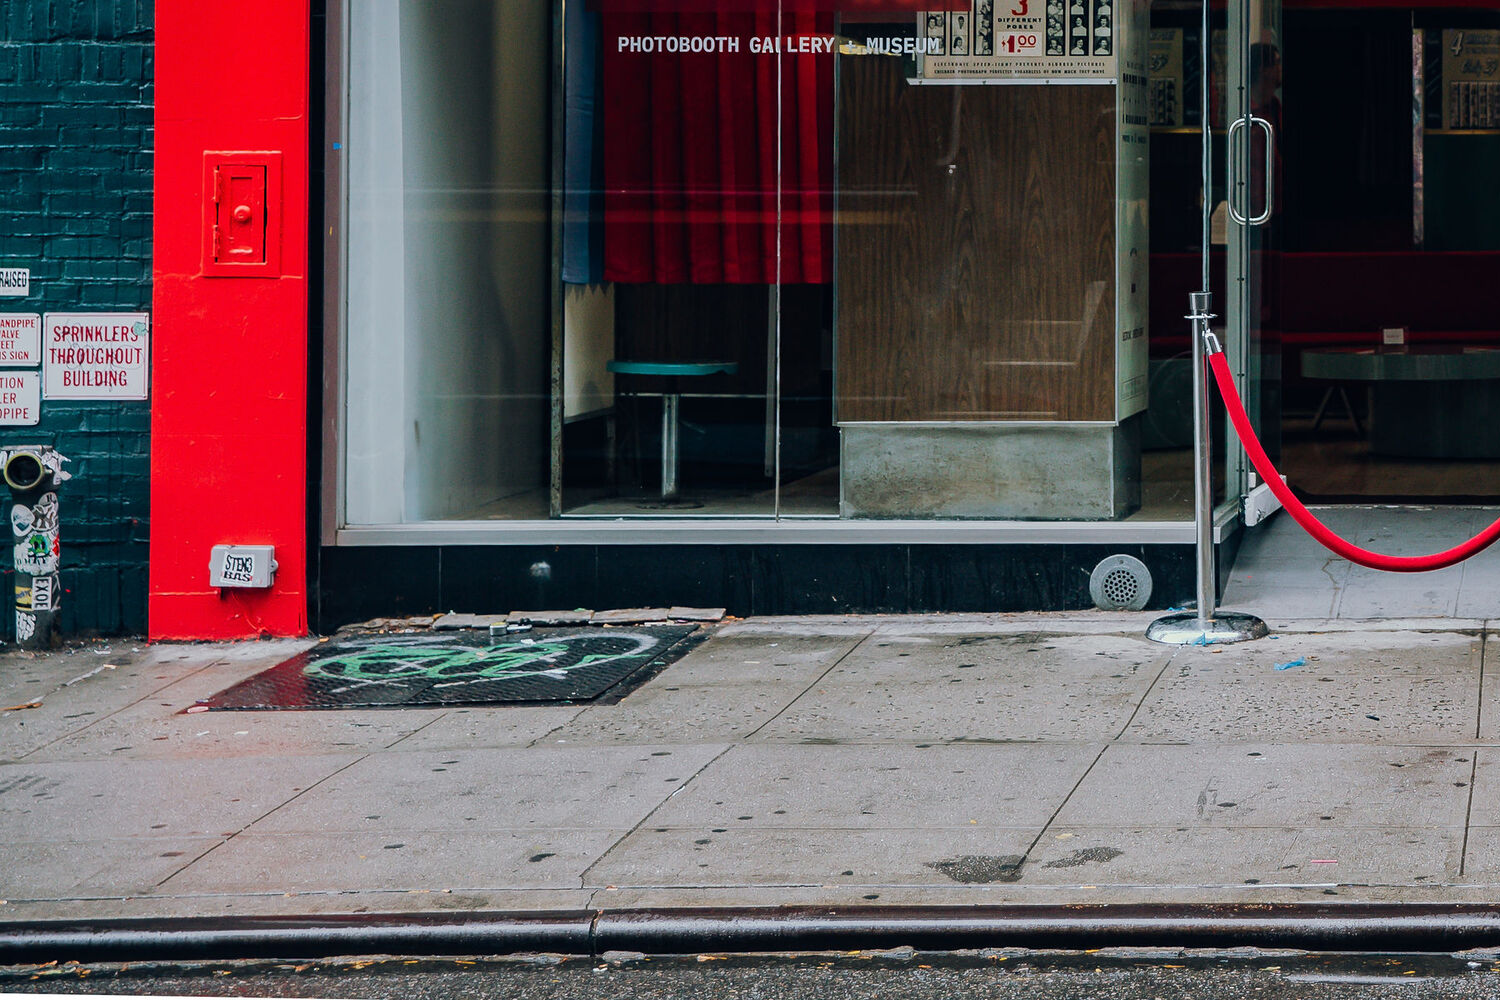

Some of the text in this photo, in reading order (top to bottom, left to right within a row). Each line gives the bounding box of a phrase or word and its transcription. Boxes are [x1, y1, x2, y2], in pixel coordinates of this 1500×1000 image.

[618, 36, 740, 53] PHOTOBOOTH
[750, 36, 835, 54] GALLERY
[866, 37, 940, 55] MUSEUM
[0, 330, 20, 339] ALVE
[53, 325, 139, 343] SPRINKLERS
[9, 351, 29, 360] SIGN
[49, 348, 143, 365] THROUGHOUT
[63, 370, 127, 387] BUILDING
[35, 578, 49, 608] EXOE
